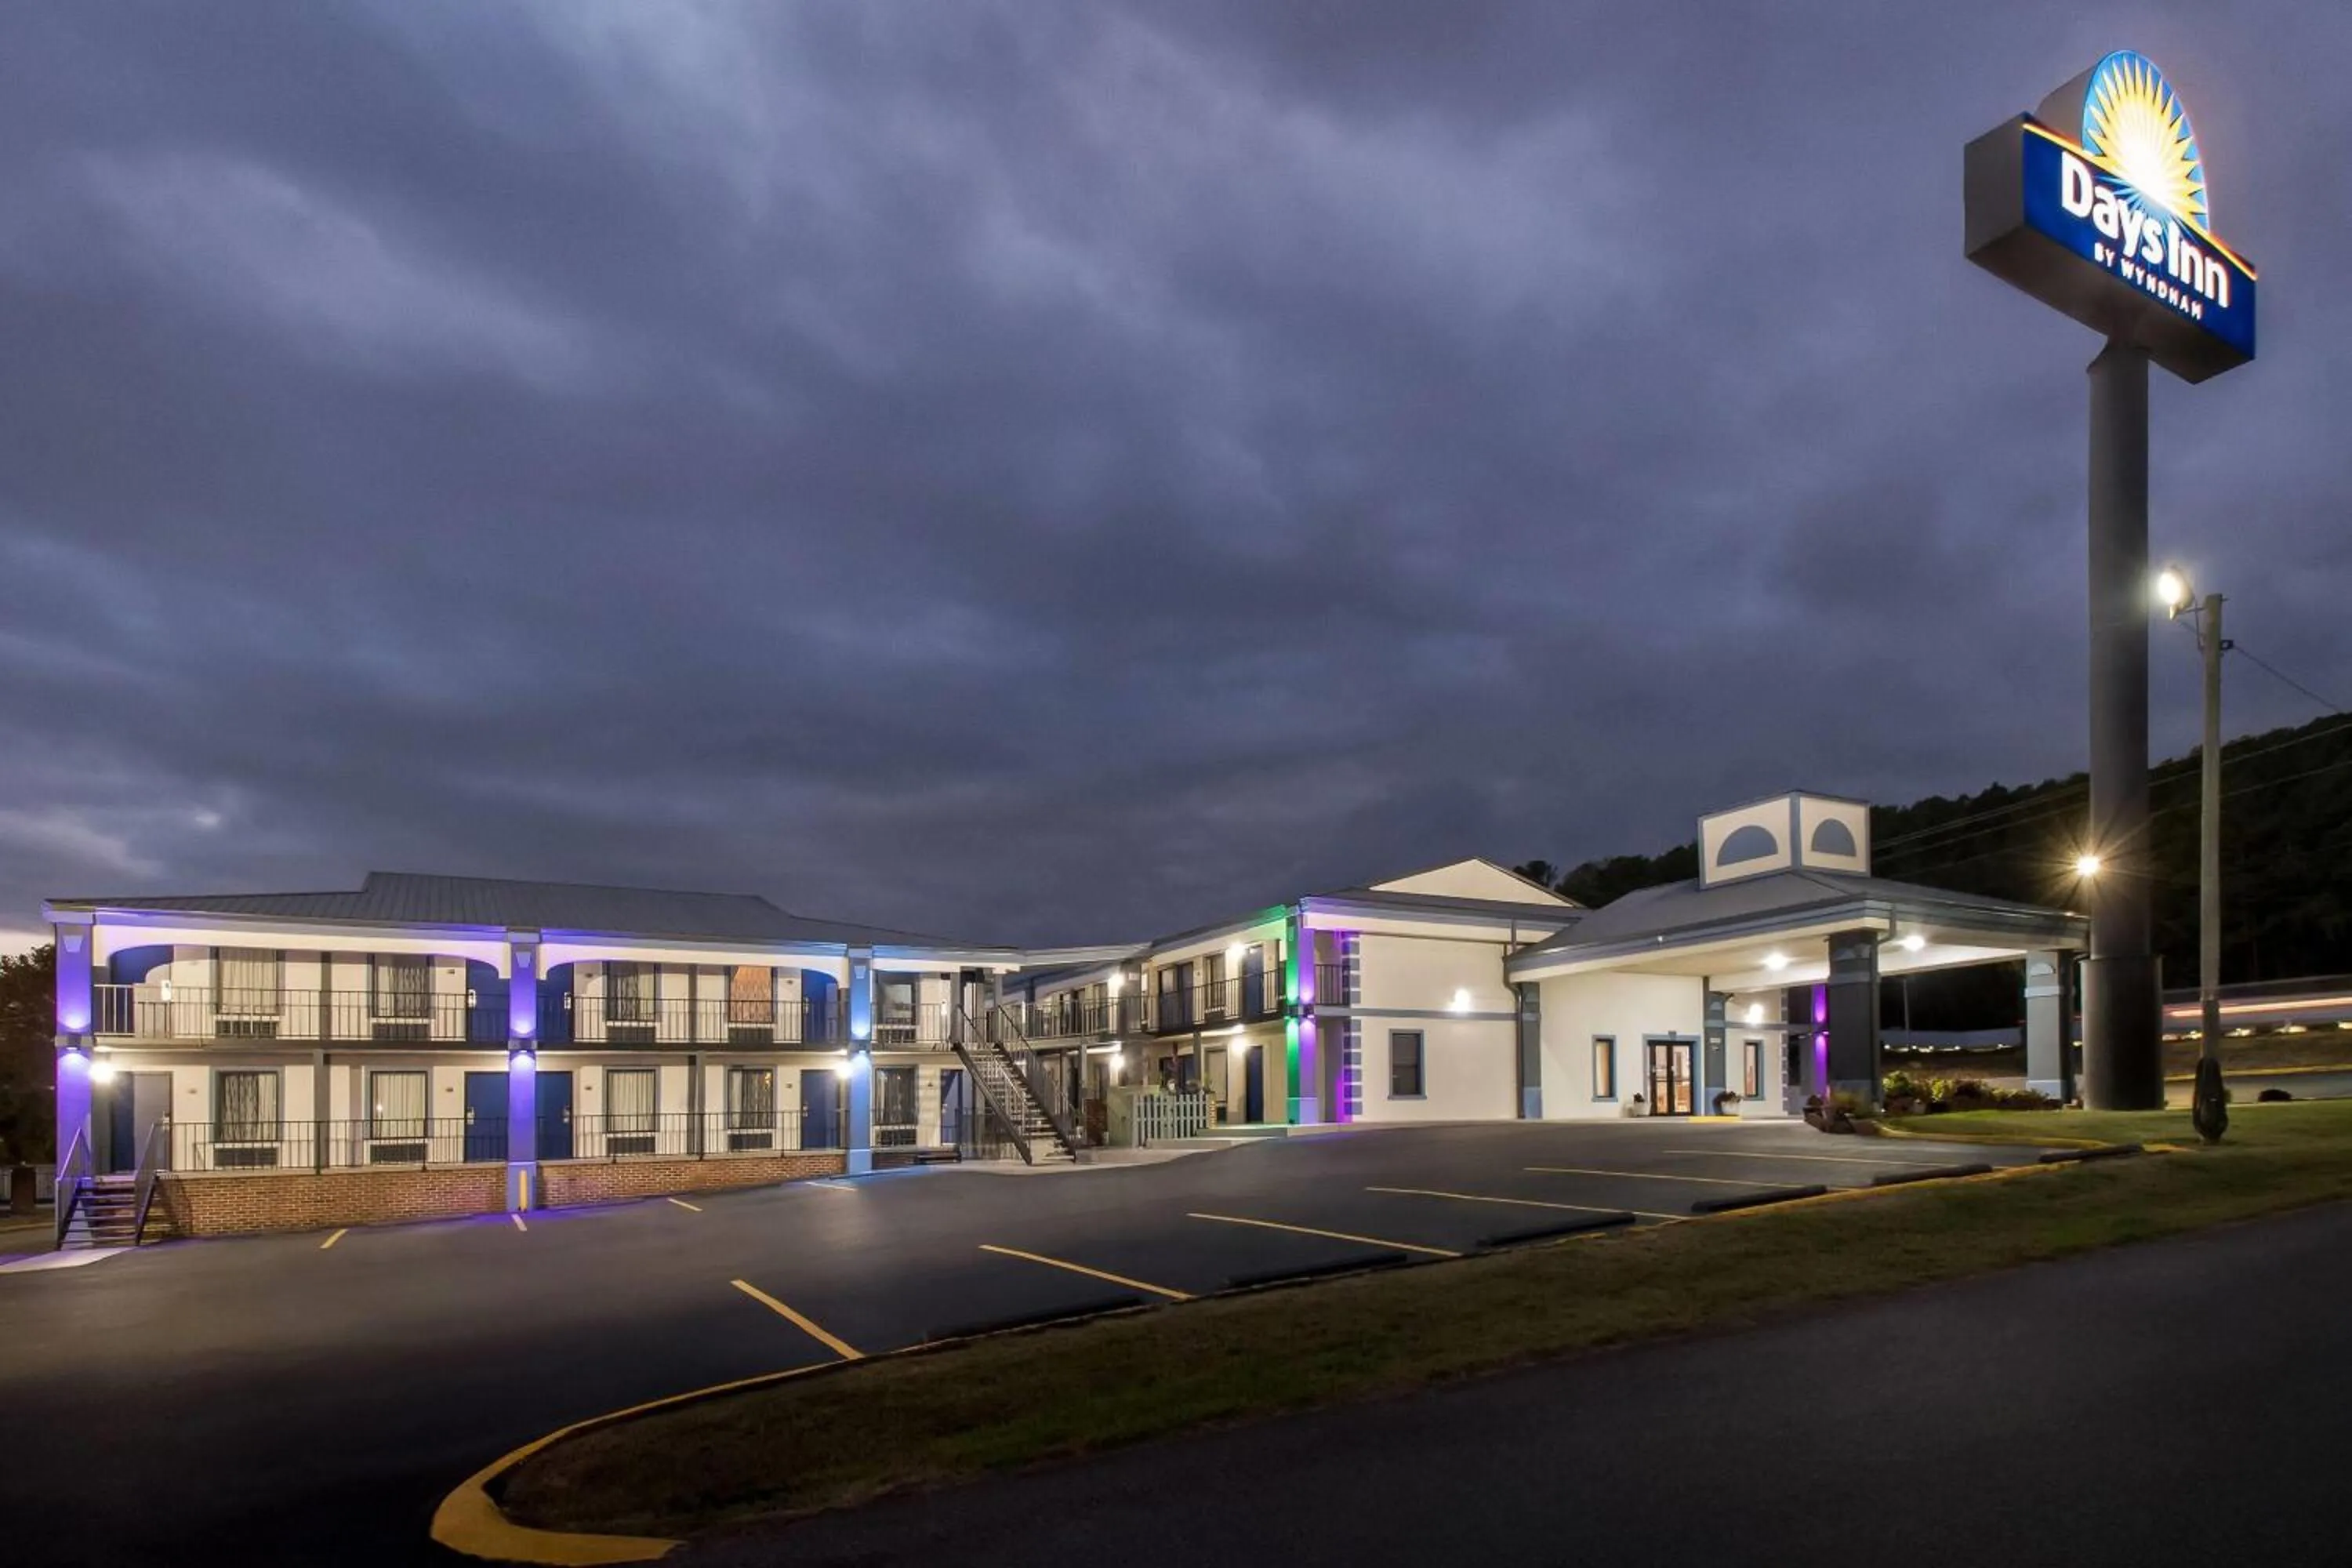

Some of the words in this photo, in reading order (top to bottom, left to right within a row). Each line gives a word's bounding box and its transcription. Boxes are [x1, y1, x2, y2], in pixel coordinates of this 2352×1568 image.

[2061, 151, 2164, 265] Days
[2169, 221, 2229, 308] Inn
[2094, 242, 2115, 267] BY
[2120, 258, 2203, 320] WYNDHAM
